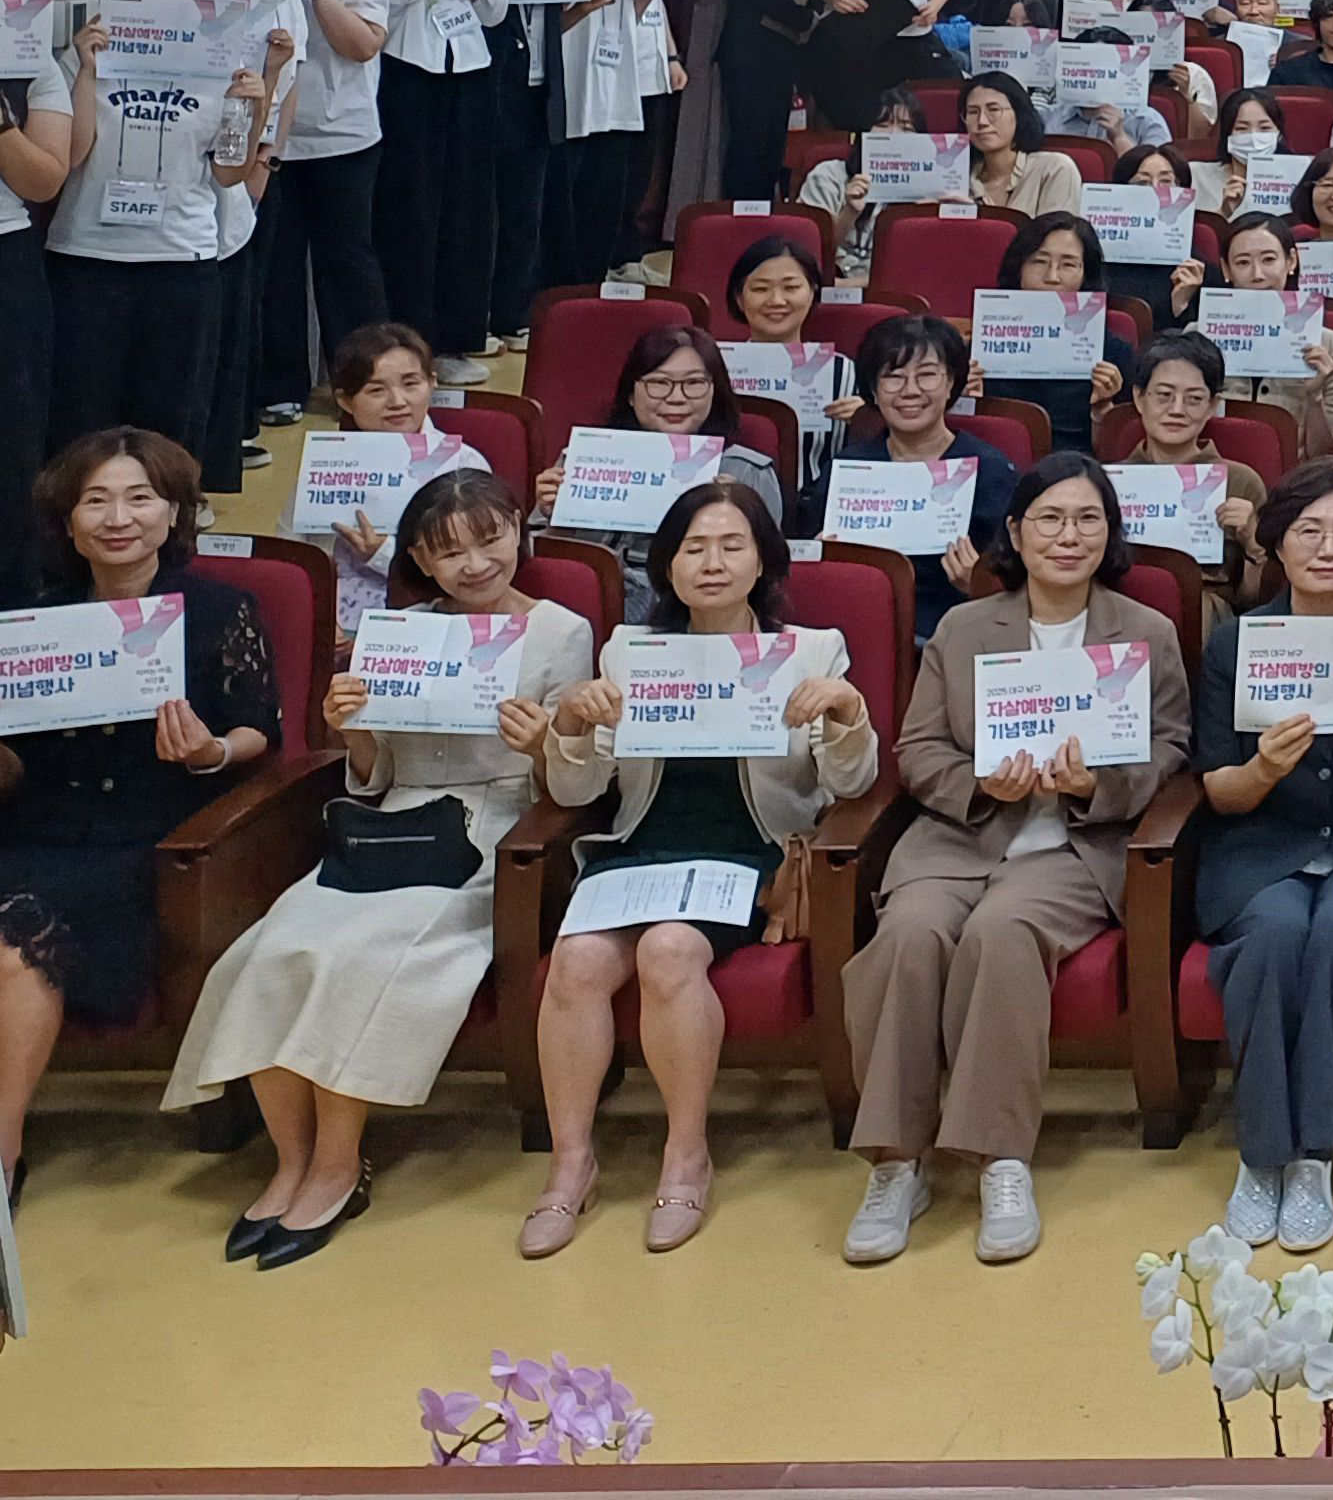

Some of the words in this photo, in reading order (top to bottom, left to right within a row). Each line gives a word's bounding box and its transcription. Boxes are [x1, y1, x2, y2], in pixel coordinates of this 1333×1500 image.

[442, 12, 472, 30] STAFF
[108, 88, 200, 113] marie
[124, 104, 180, 122] claire
[110, 201, 158, 215] STAFF
[1212, 340, 1252, 351] 념행사
[98, 648, 117, 666] 날
[360, 656, 440, 676] 자살예방의
[444, 660, 462, 677] 날
[1247, 661, 1328, 678] 자살예방의
[628, 682, 712, 700] 자살예방의
[717, 682, 735, 698] 날
[1247, 683, 1312, 700] 기념행사
[628, 704, 694, 722] 기념행사
[987, 695, 1069, 717] 자살예방의
[1075, 692, 1092, 710] 날
[987, 718, 1054, 739] 기념행사
